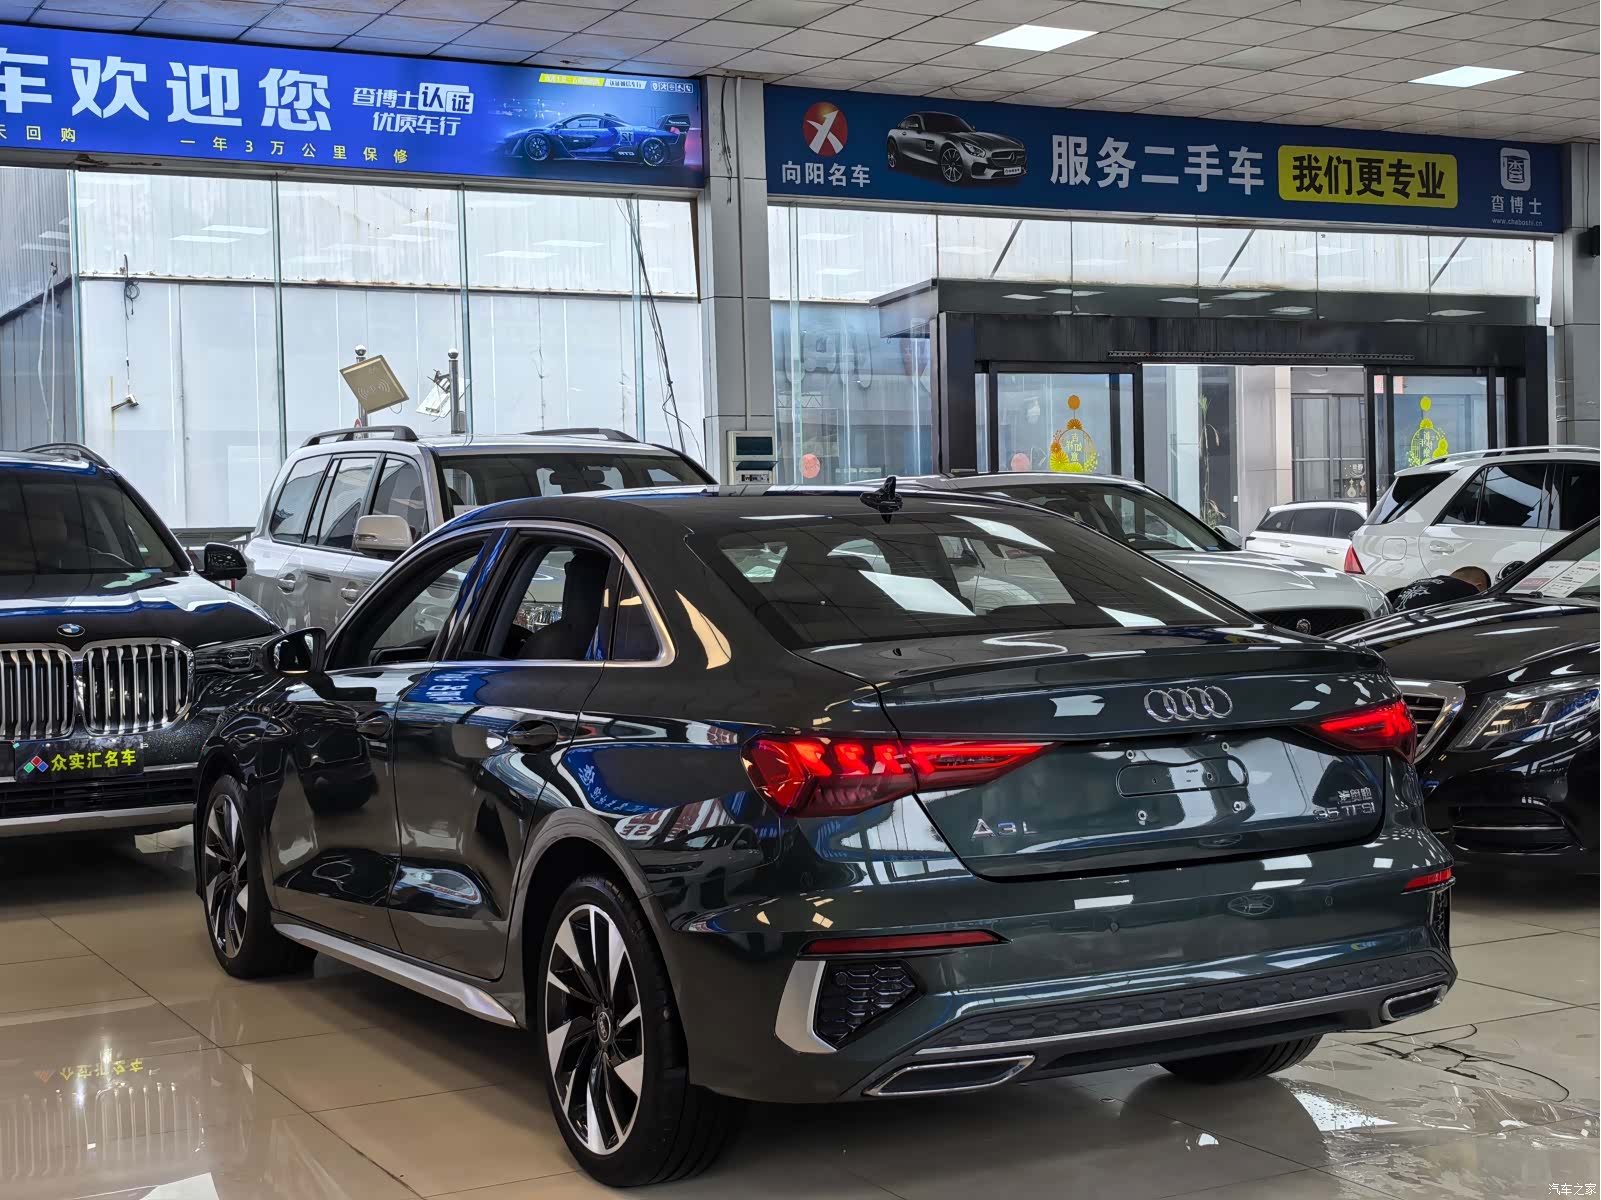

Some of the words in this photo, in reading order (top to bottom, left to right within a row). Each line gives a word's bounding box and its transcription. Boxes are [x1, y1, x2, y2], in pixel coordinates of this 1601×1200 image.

[0, 47, 332, 131] 车欢迎您
[352, 84, 472, 113] 查博士认证
[373, 111, 461, 136] 优质车行
[180, 136, 408, 163] 一年3万公里保修
[781, 160, 871, 187] 向阳名车
[1050, 134, 1265, 195] 服务二手车
[1292, 153, 1446, 200] 我们更专业
[1490, 195, 1542, 215] 查博士
[51, 748, 136, 771] 众实汇名车
[1341, 801, 1376, 816] TFSI
